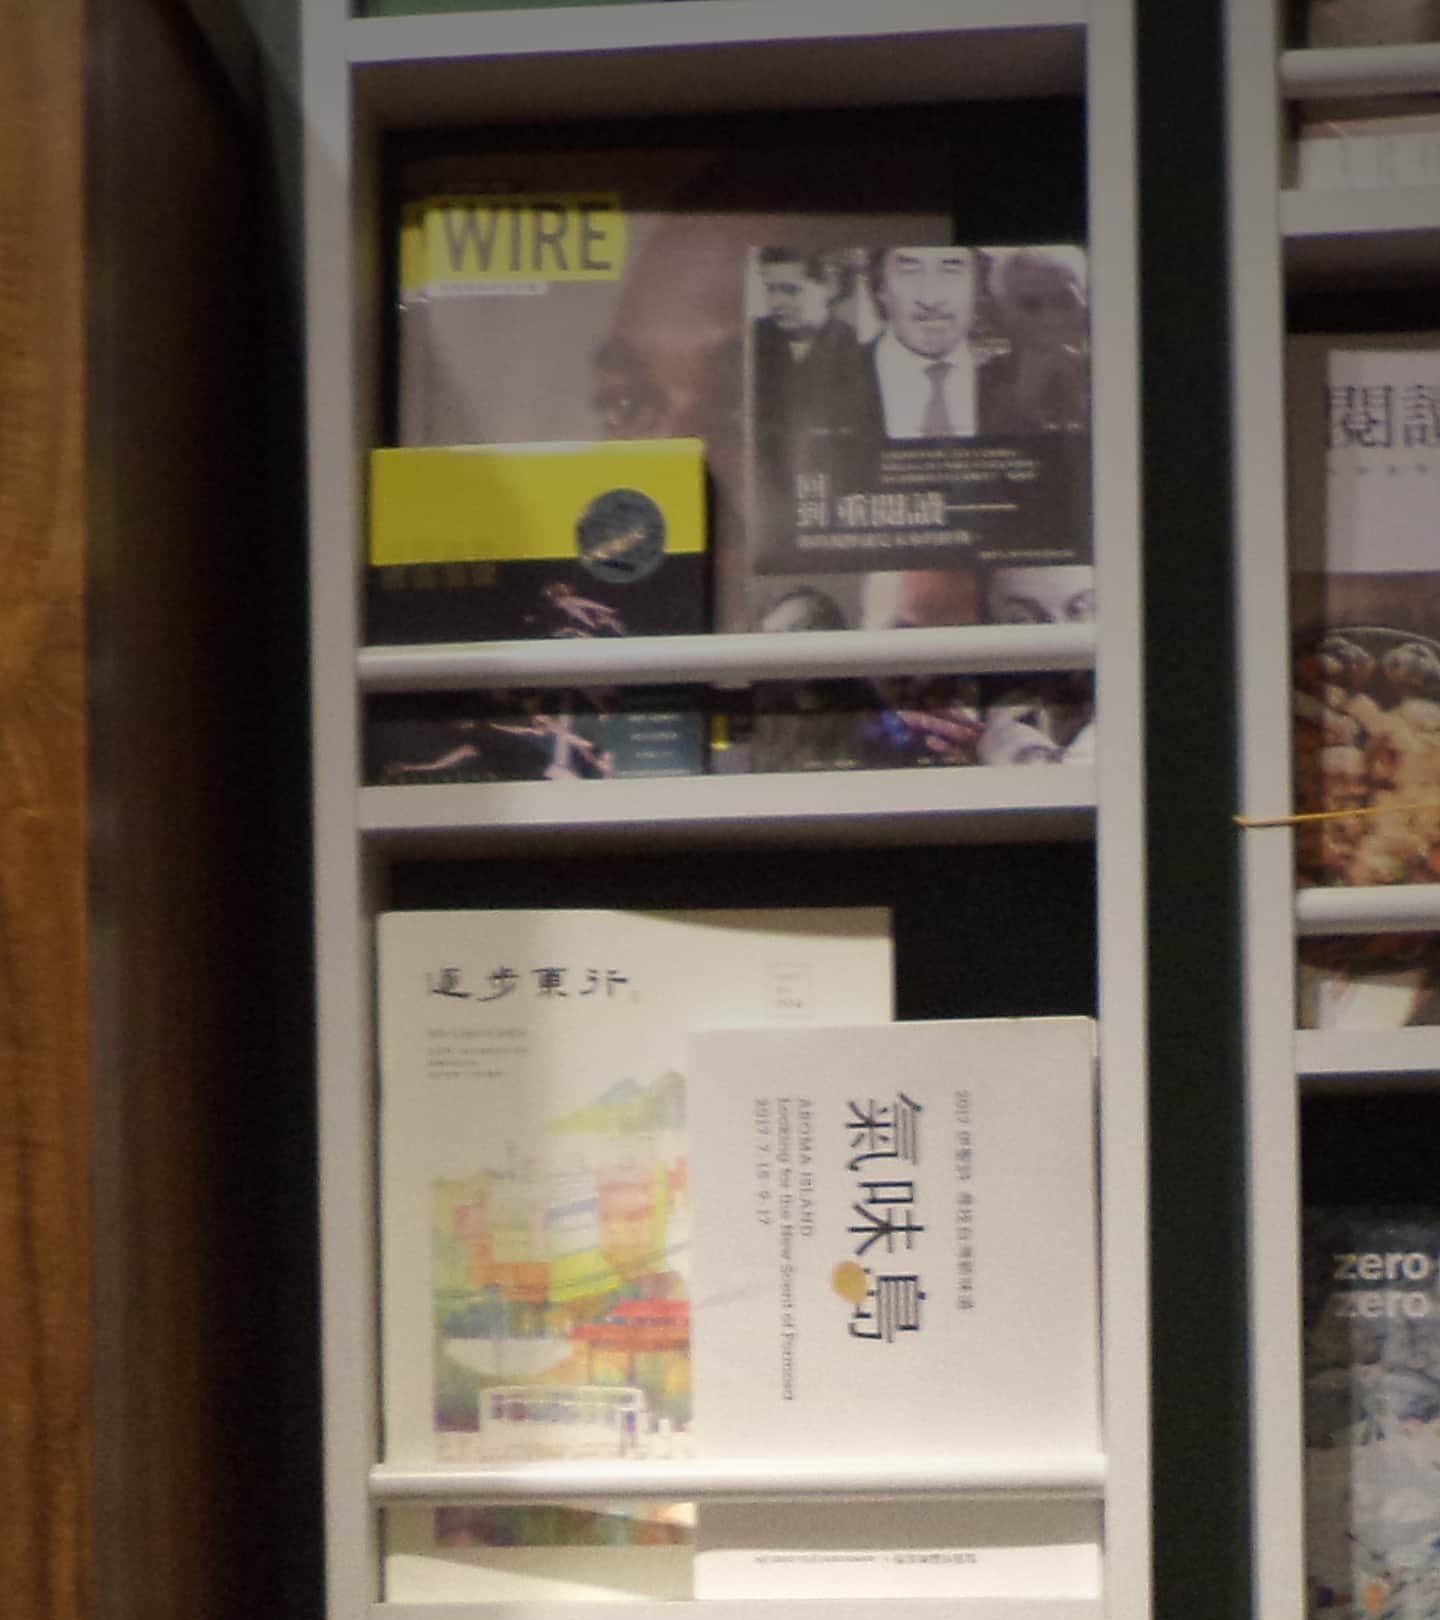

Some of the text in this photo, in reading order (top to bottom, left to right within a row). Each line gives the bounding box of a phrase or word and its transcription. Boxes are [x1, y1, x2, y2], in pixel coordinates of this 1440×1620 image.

[443, 202, 612, 272] WIRE
[798, 1097, 816, 1238] AROMA ISLAND
[844, 1092, 927, 1343] 氣味島
[1332, 1251, 1431, 1282] zero
[1334, 1288, 1431, 1319] zero
